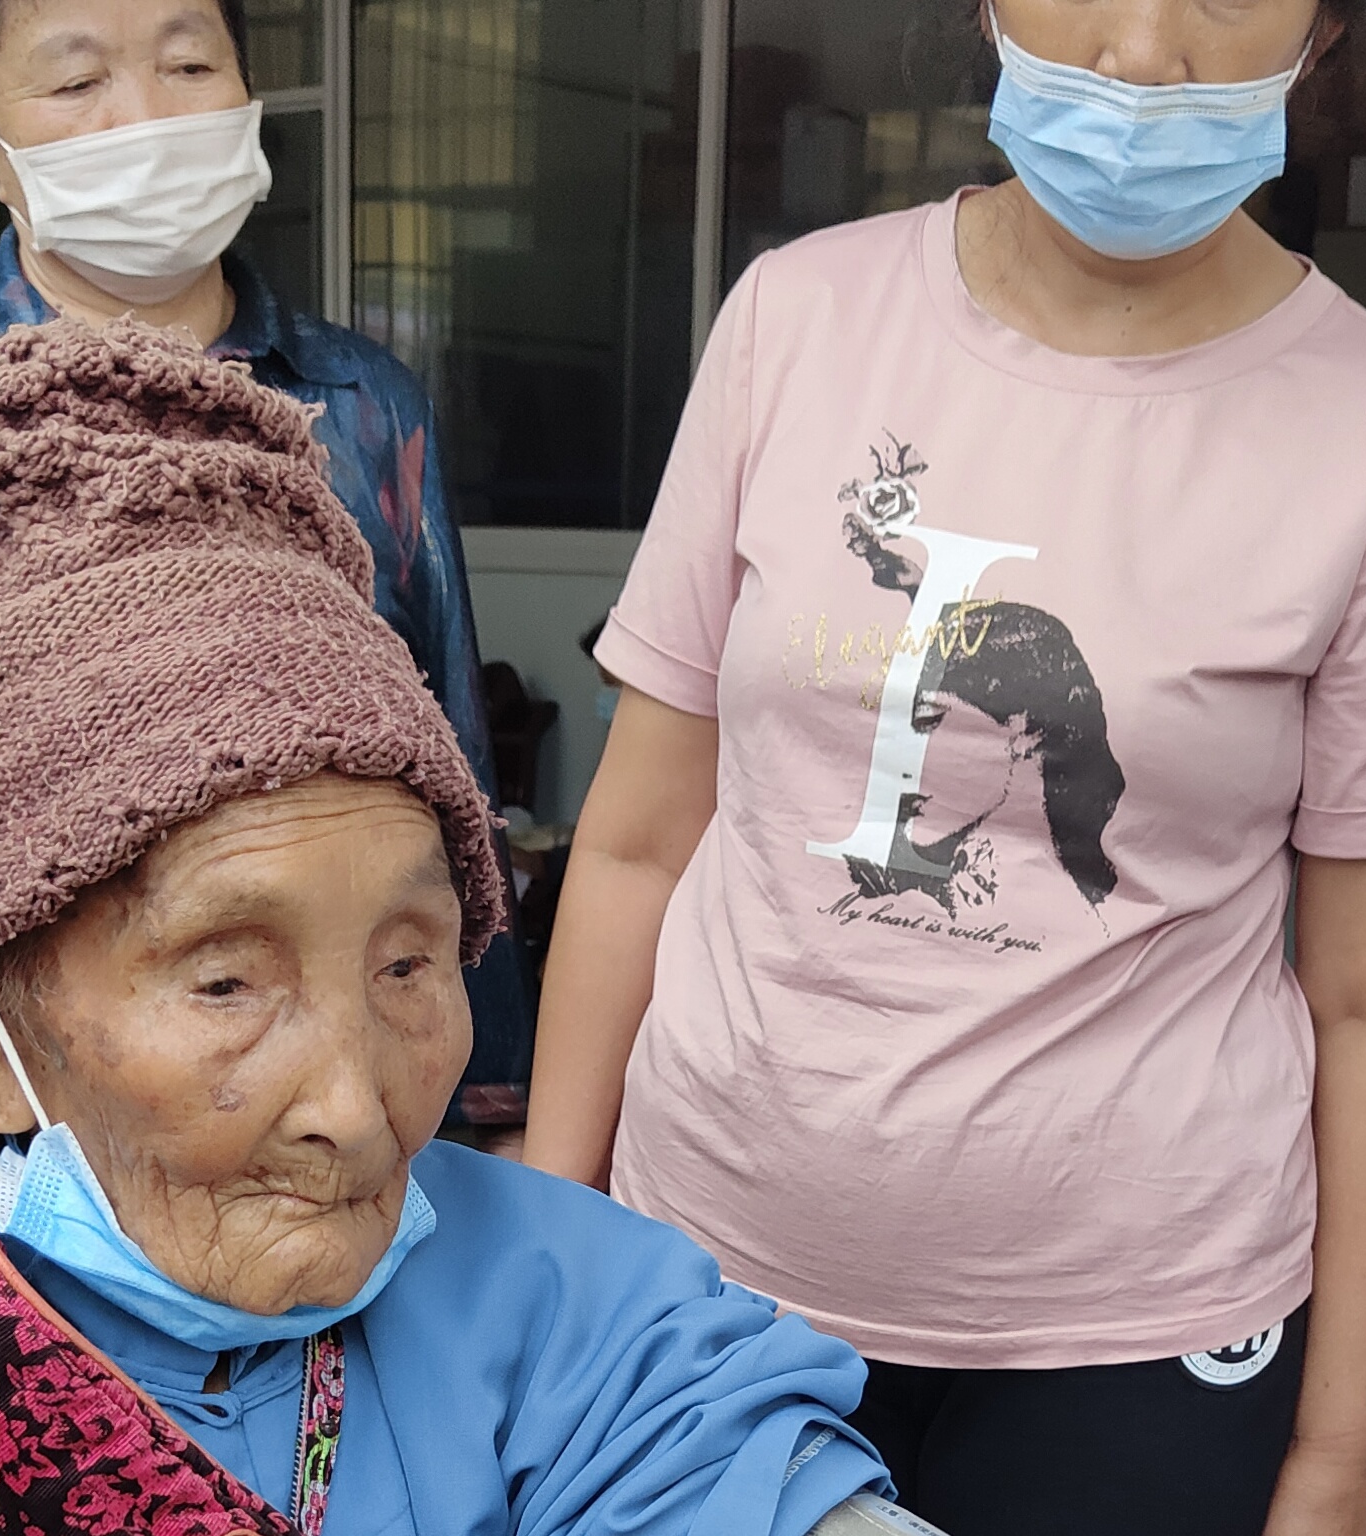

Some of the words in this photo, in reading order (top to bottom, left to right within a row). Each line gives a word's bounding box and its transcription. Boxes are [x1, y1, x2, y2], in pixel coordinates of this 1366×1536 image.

[782, 586, 1006, 711] Elegant
[817, 891, 862, 925] My
[867, 903, 925, 929] heart
[925, 919, 942, 933] is
[949, 923, 1009, 944] with
